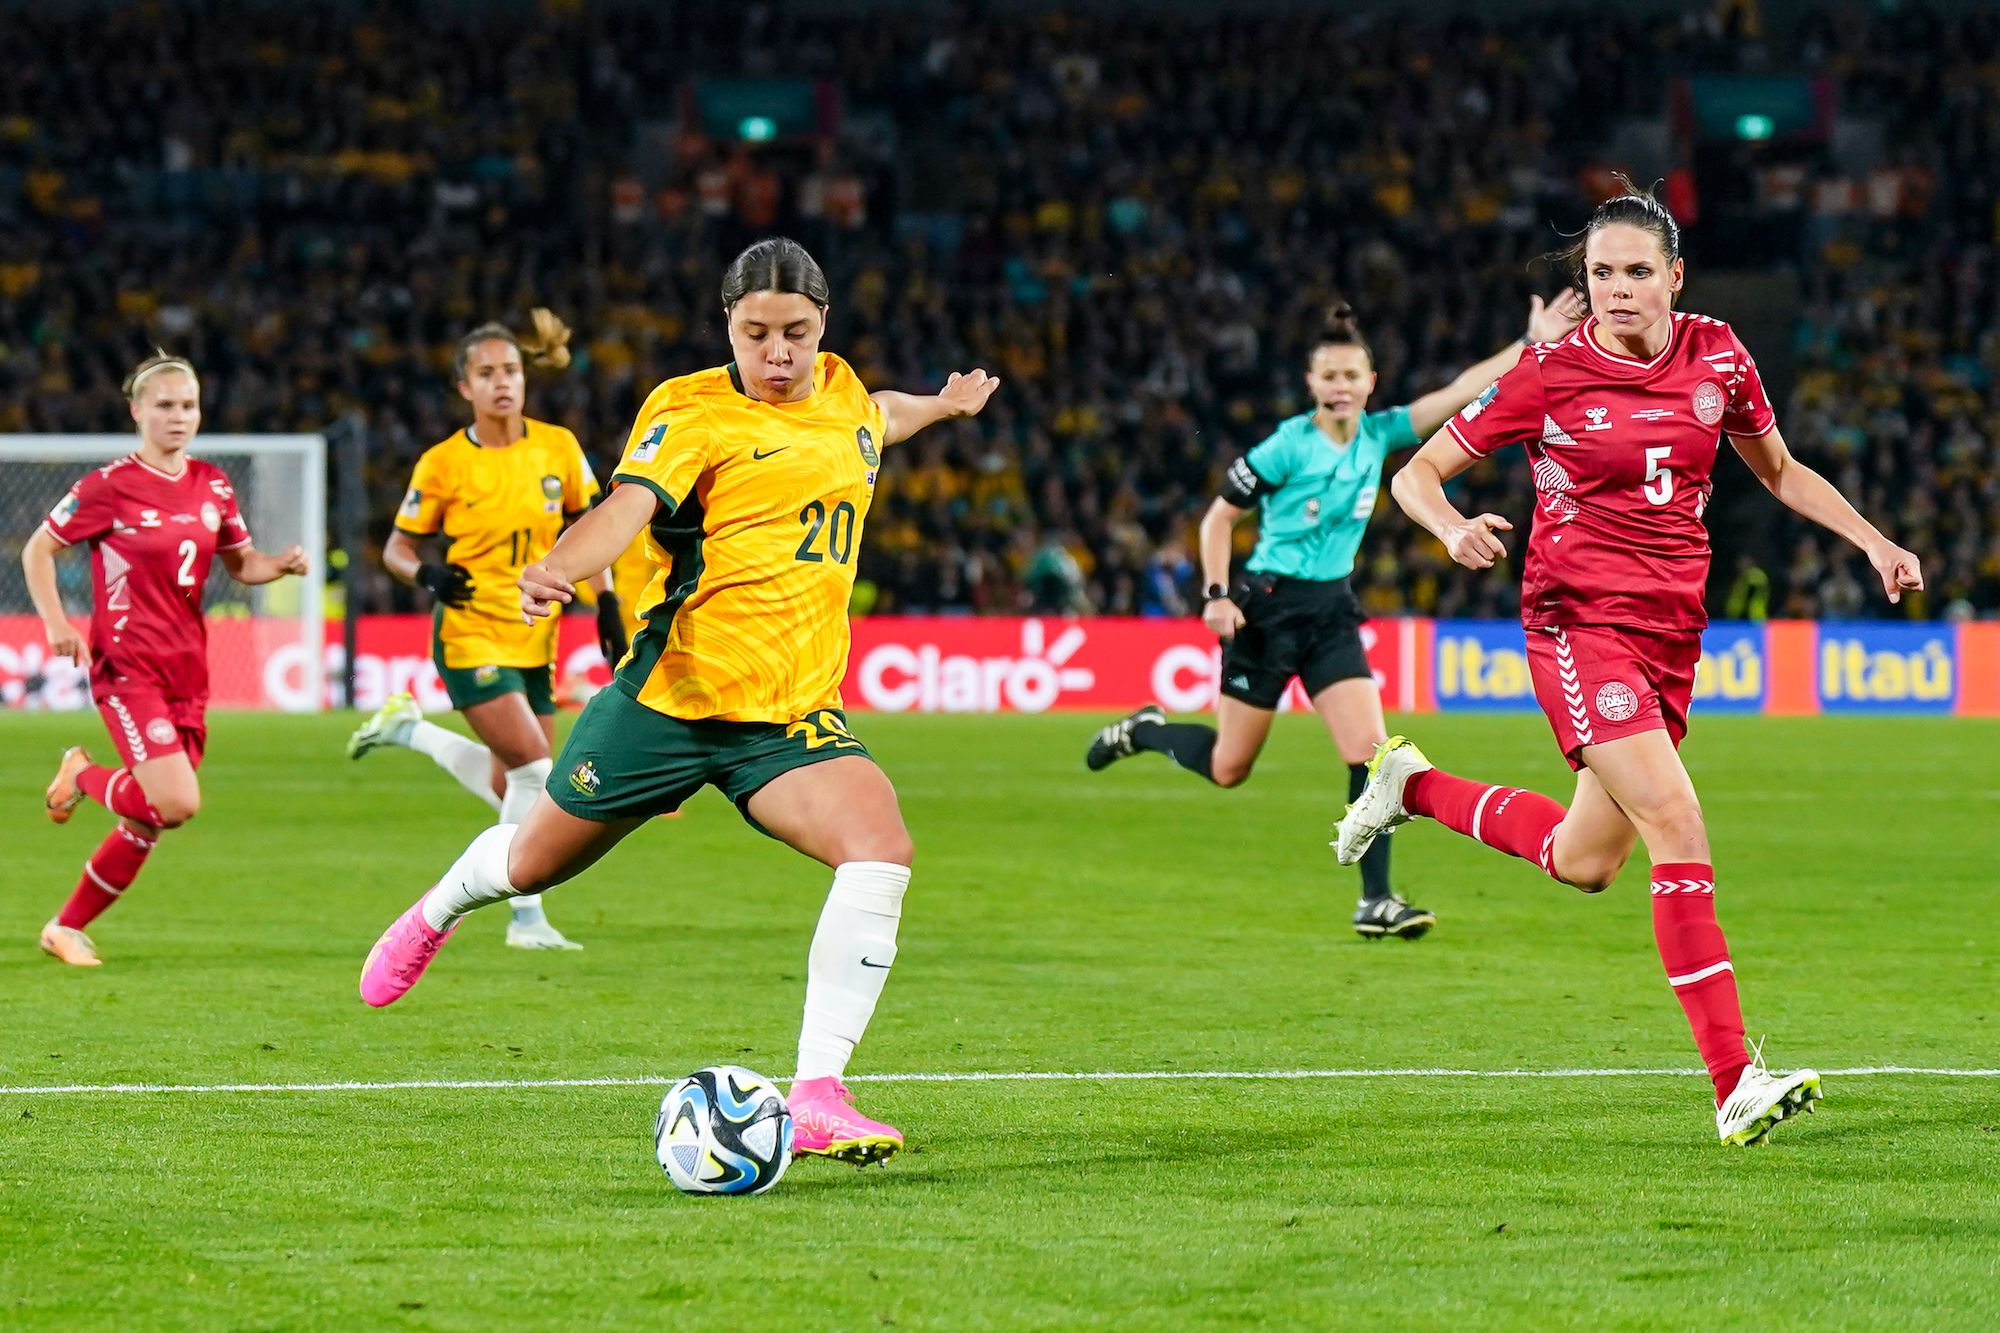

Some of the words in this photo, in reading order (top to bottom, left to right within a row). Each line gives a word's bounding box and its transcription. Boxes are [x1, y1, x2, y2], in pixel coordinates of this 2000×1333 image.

[1698, 396, 1717, 409] DBU
[1643, 446, 1673, 506] 5
[177, 539, 198, 586] 2
[511, 528, 531, 566] 11
[795, 500, 855, 565] 20
[858, 642, 1060, 713] Claro
[1440, 636, 1528, 698] Ita
[1694, 638, 1761, 698] aú
[1822, 639, 1951, 699] Itaú
[1605, 694, 1630, 708] DBU
